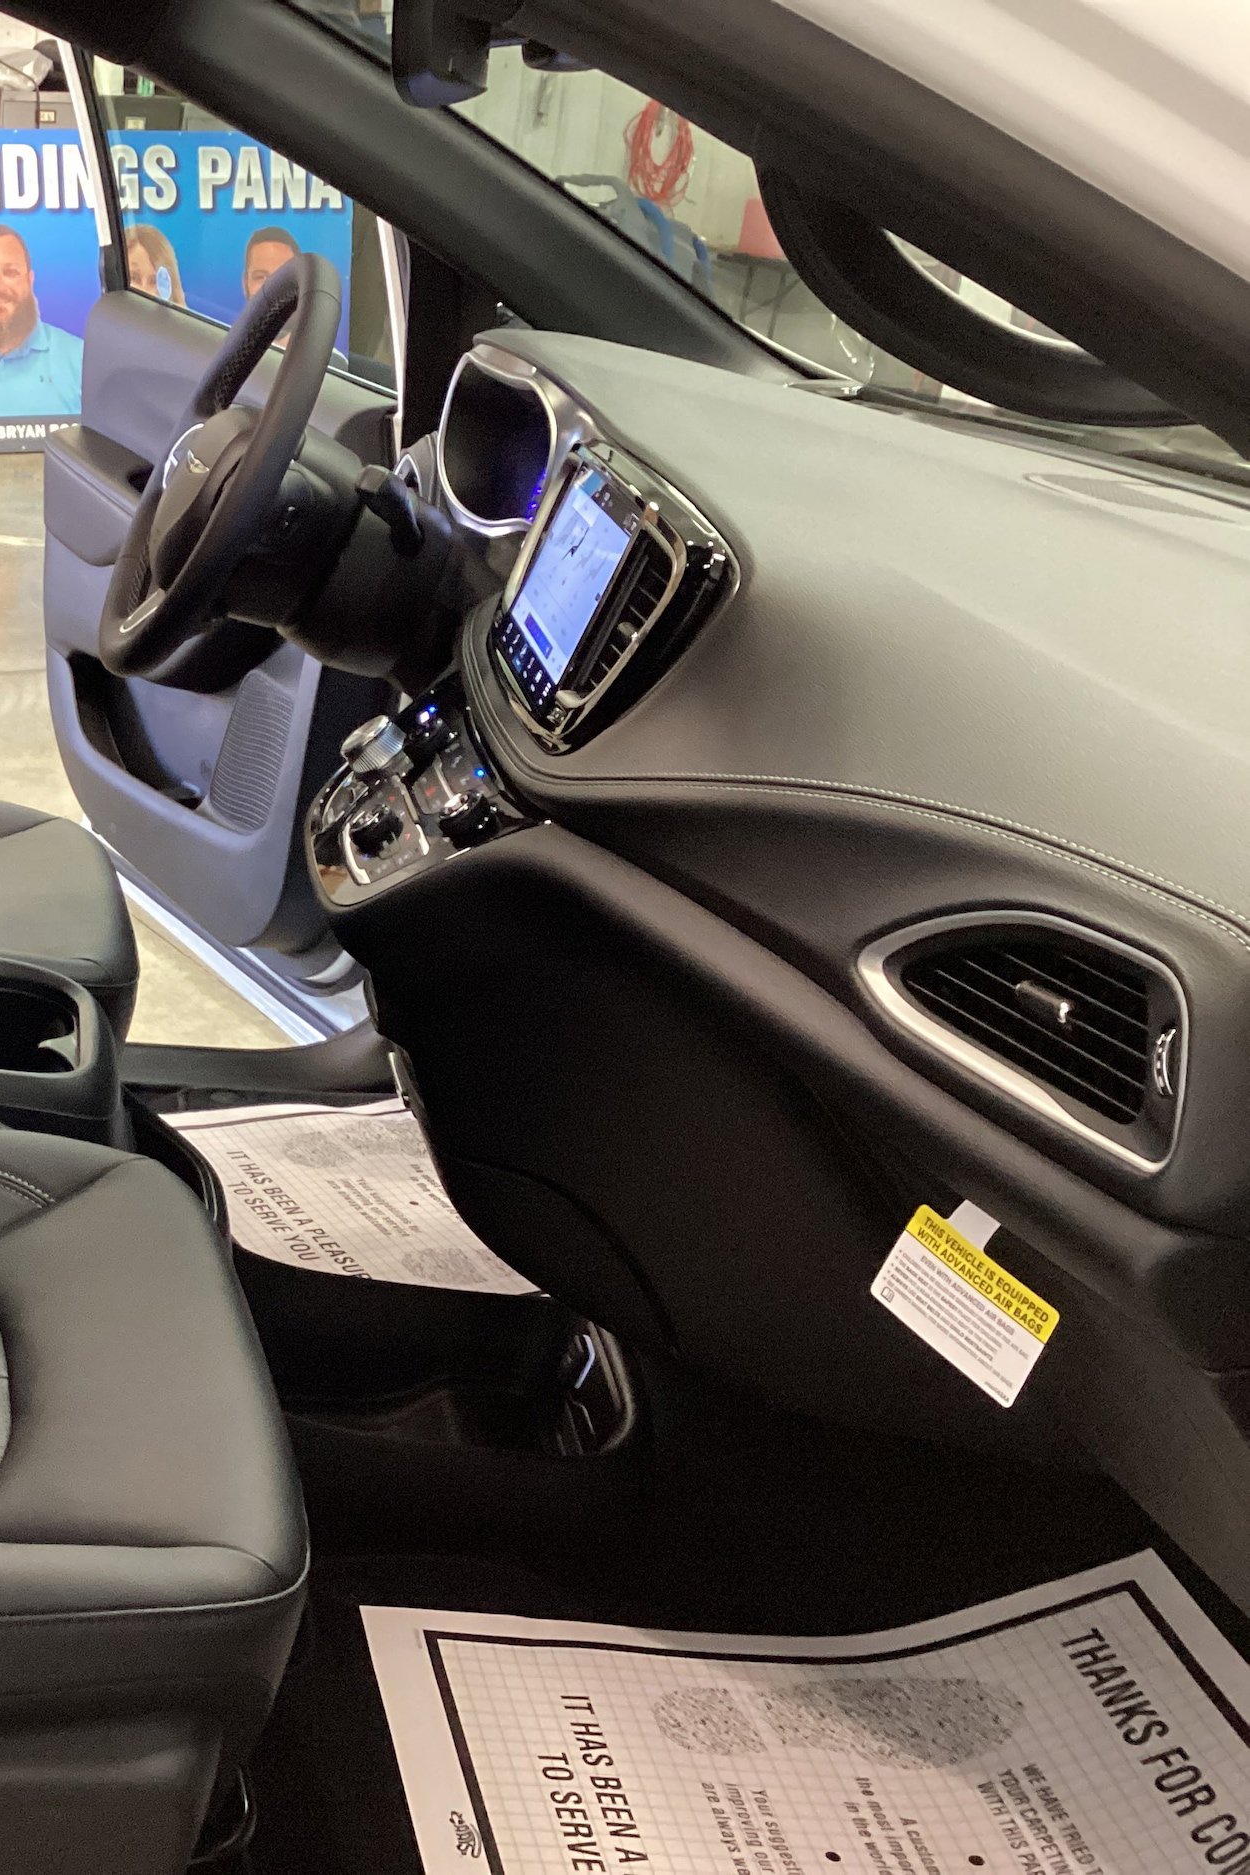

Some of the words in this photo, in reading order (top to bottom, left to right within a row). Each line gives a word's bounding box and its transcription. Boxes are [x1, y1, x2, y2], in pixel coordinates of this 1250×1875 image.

[226, 1151, 250, 1160] IT
[238, 1163, 272, 1185] HAS
[262, 1187, 305, 1215] BEEN
[227, 1181, 253, 1196] TO
[244, 1197, 293, 1233] SERVE
[283, 1234, 321, 1261] YOU
[917, 1227, 941, 1252] WITH
[940, 1249, 994, 1295] ADVANCED
[993, 1293, 1013, 1311] AIR
[1013, 1307, 1043, 1335] BAGS
[924, 1216, 945, 1239] THIS
[945, 1233, 985, 1272] VEHICLE
[984, 1267, 996, 1281] IS
[996, 1277, 1049, 1323] EQUIPPED
[560, 1695, 595, 1714] IT
[1061, 1627, 1170, 1746] THANKS
[1140, 1746, 1216, 1817] FOR
[537, 1752, 574, 1781] TO
[570, 1722, 614, 1767] HAS
[549, 1790, 606, 1873] SERVE
[589, 1776, 641, 1839] BEEN
[701, 1782, 721, 1803] are
[711, 1807, 741, 1854] always
[725, 1783, 764, 1847] improving
[753, 1851, 776, 1874] our
[752, 1790, 774, 1817] Your
[977, 1781, 1010, 1816] WITH
[999, 1817, 1029, 1850] THIS
[614, 1847, 649, 1863] A
